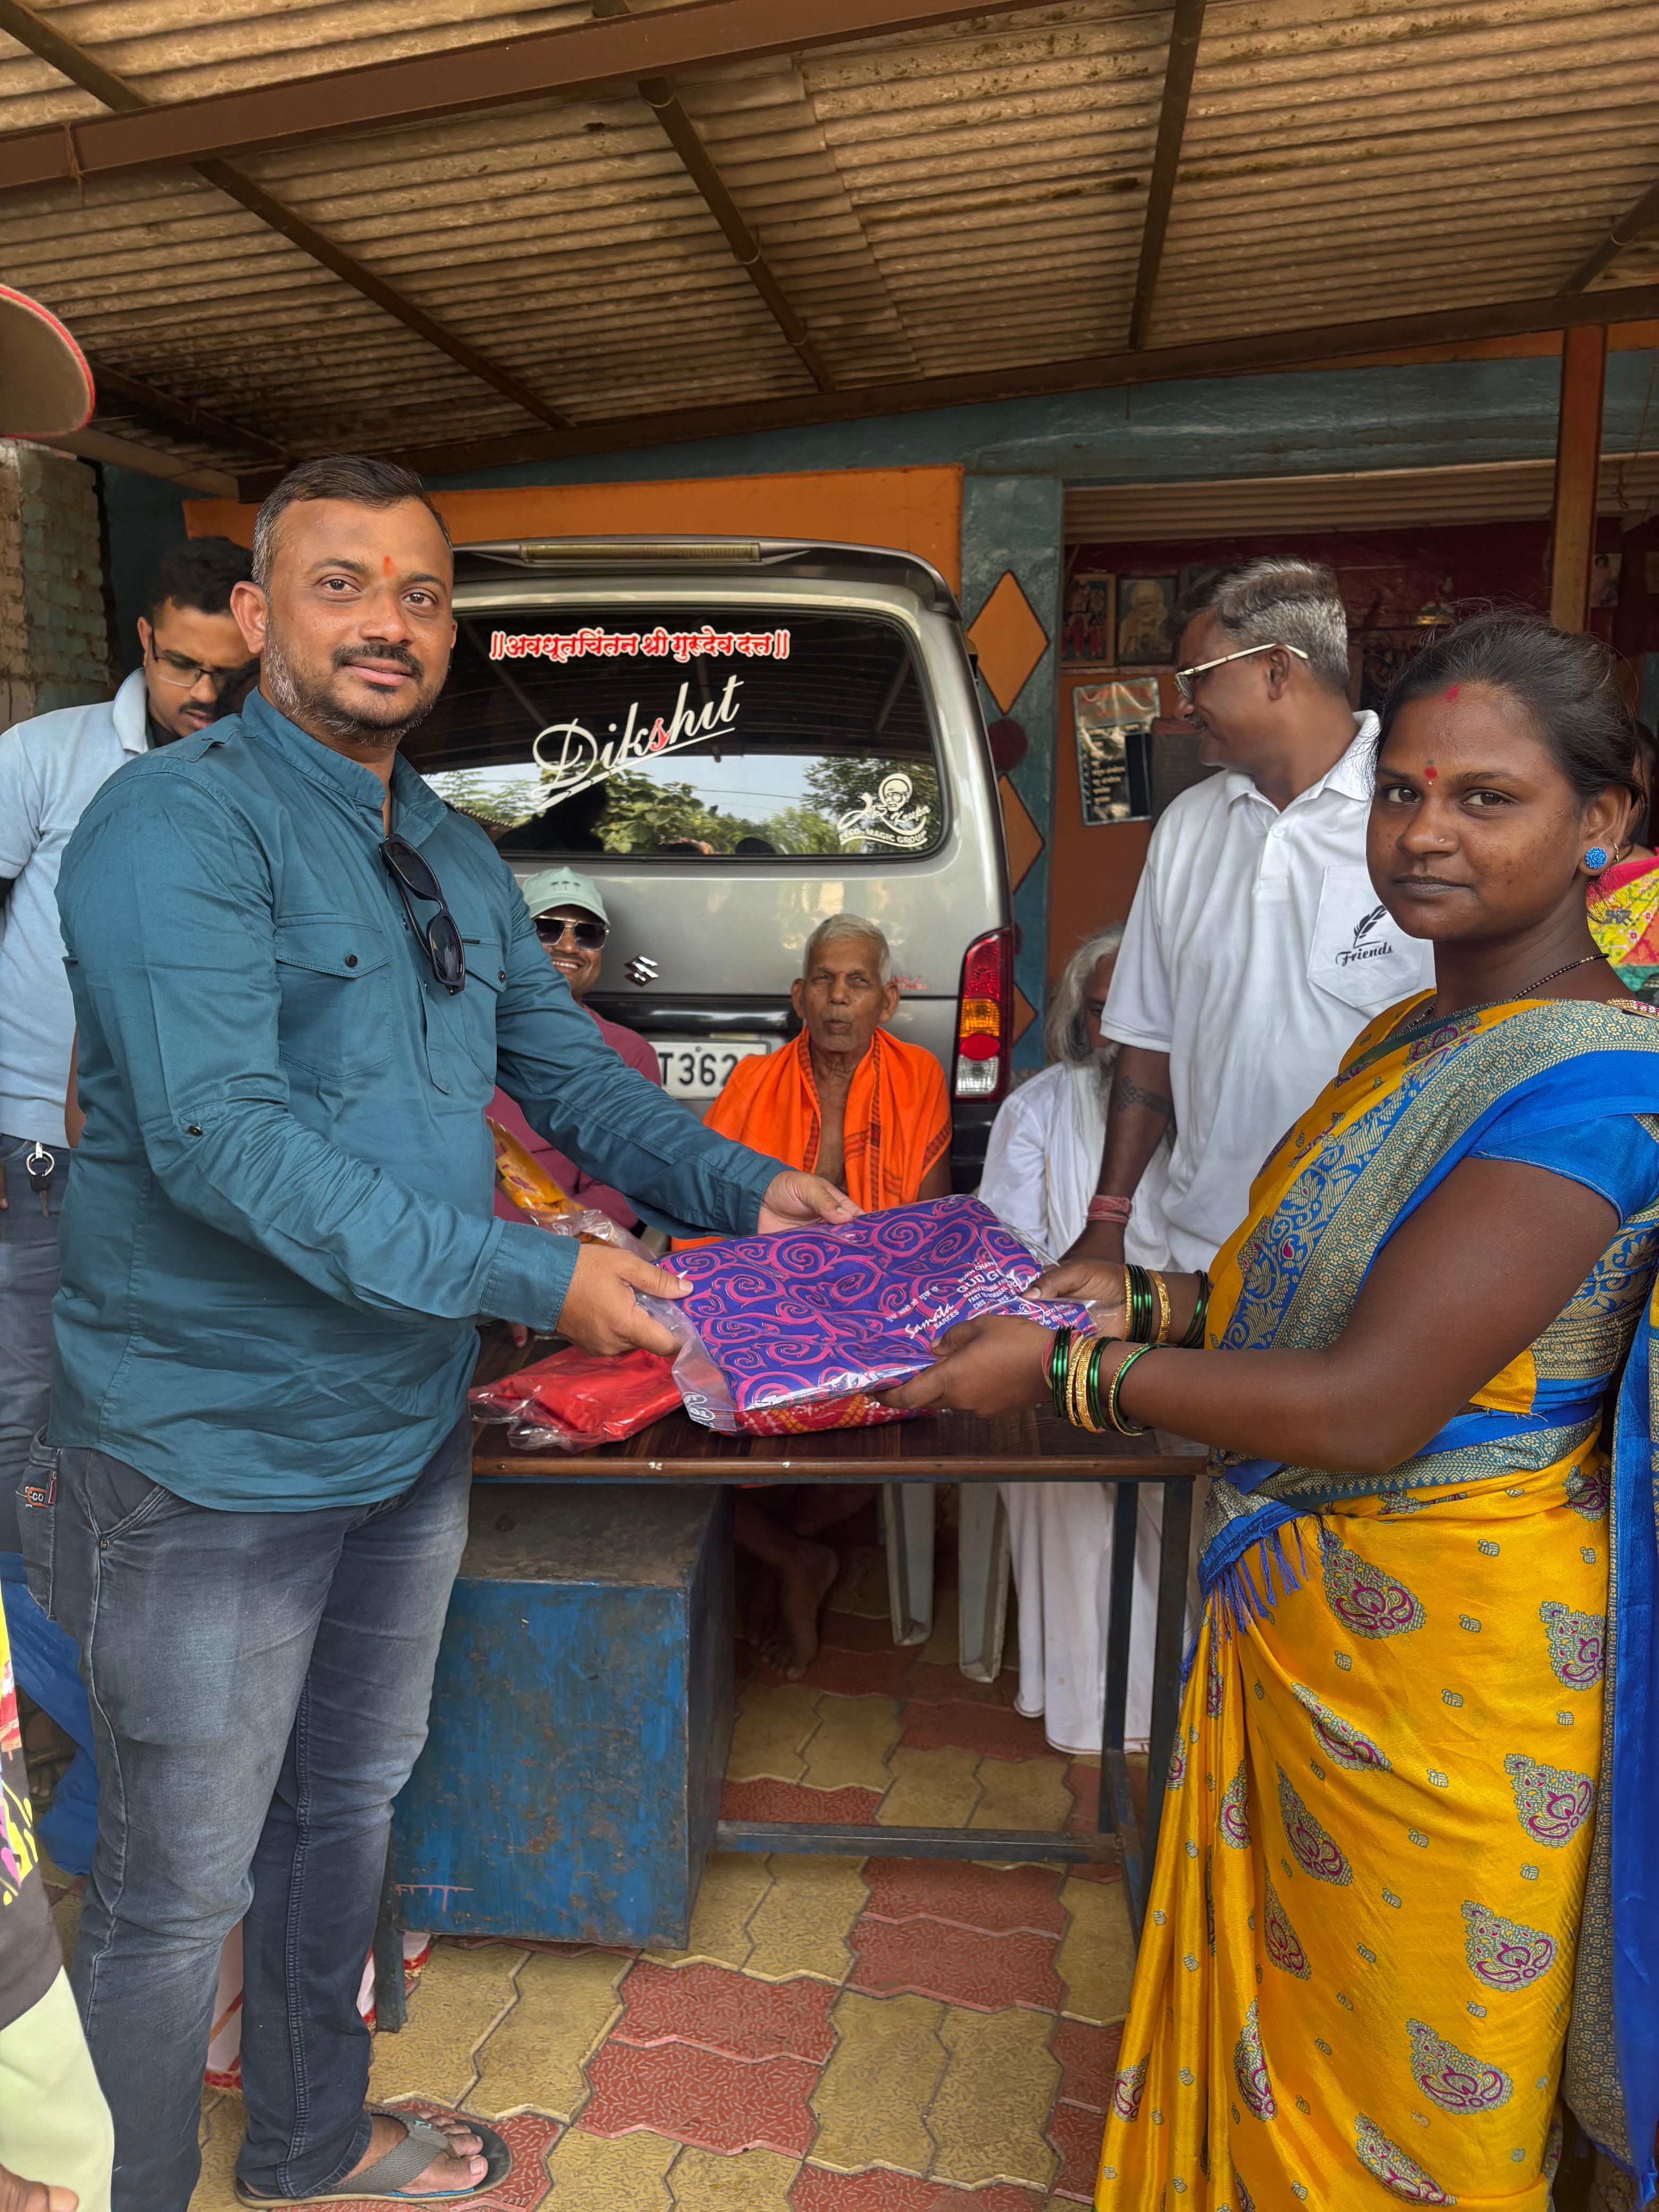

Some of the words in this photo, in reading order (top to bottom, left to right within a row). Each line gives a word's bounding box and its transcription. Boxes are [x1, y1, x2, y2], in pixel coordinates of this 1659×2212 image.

[640, 626, 671, 658] श्री
[530, 674, 745, 800] Dikshit
[896, 830, 927, 844] GROUP
[1335, 942, 1395, 967] Friends
[657, 1052, 756, 1086] T362
[904, 1303, 954, 1339] Samata
[933, 1309, 960, 1329] SAREES
